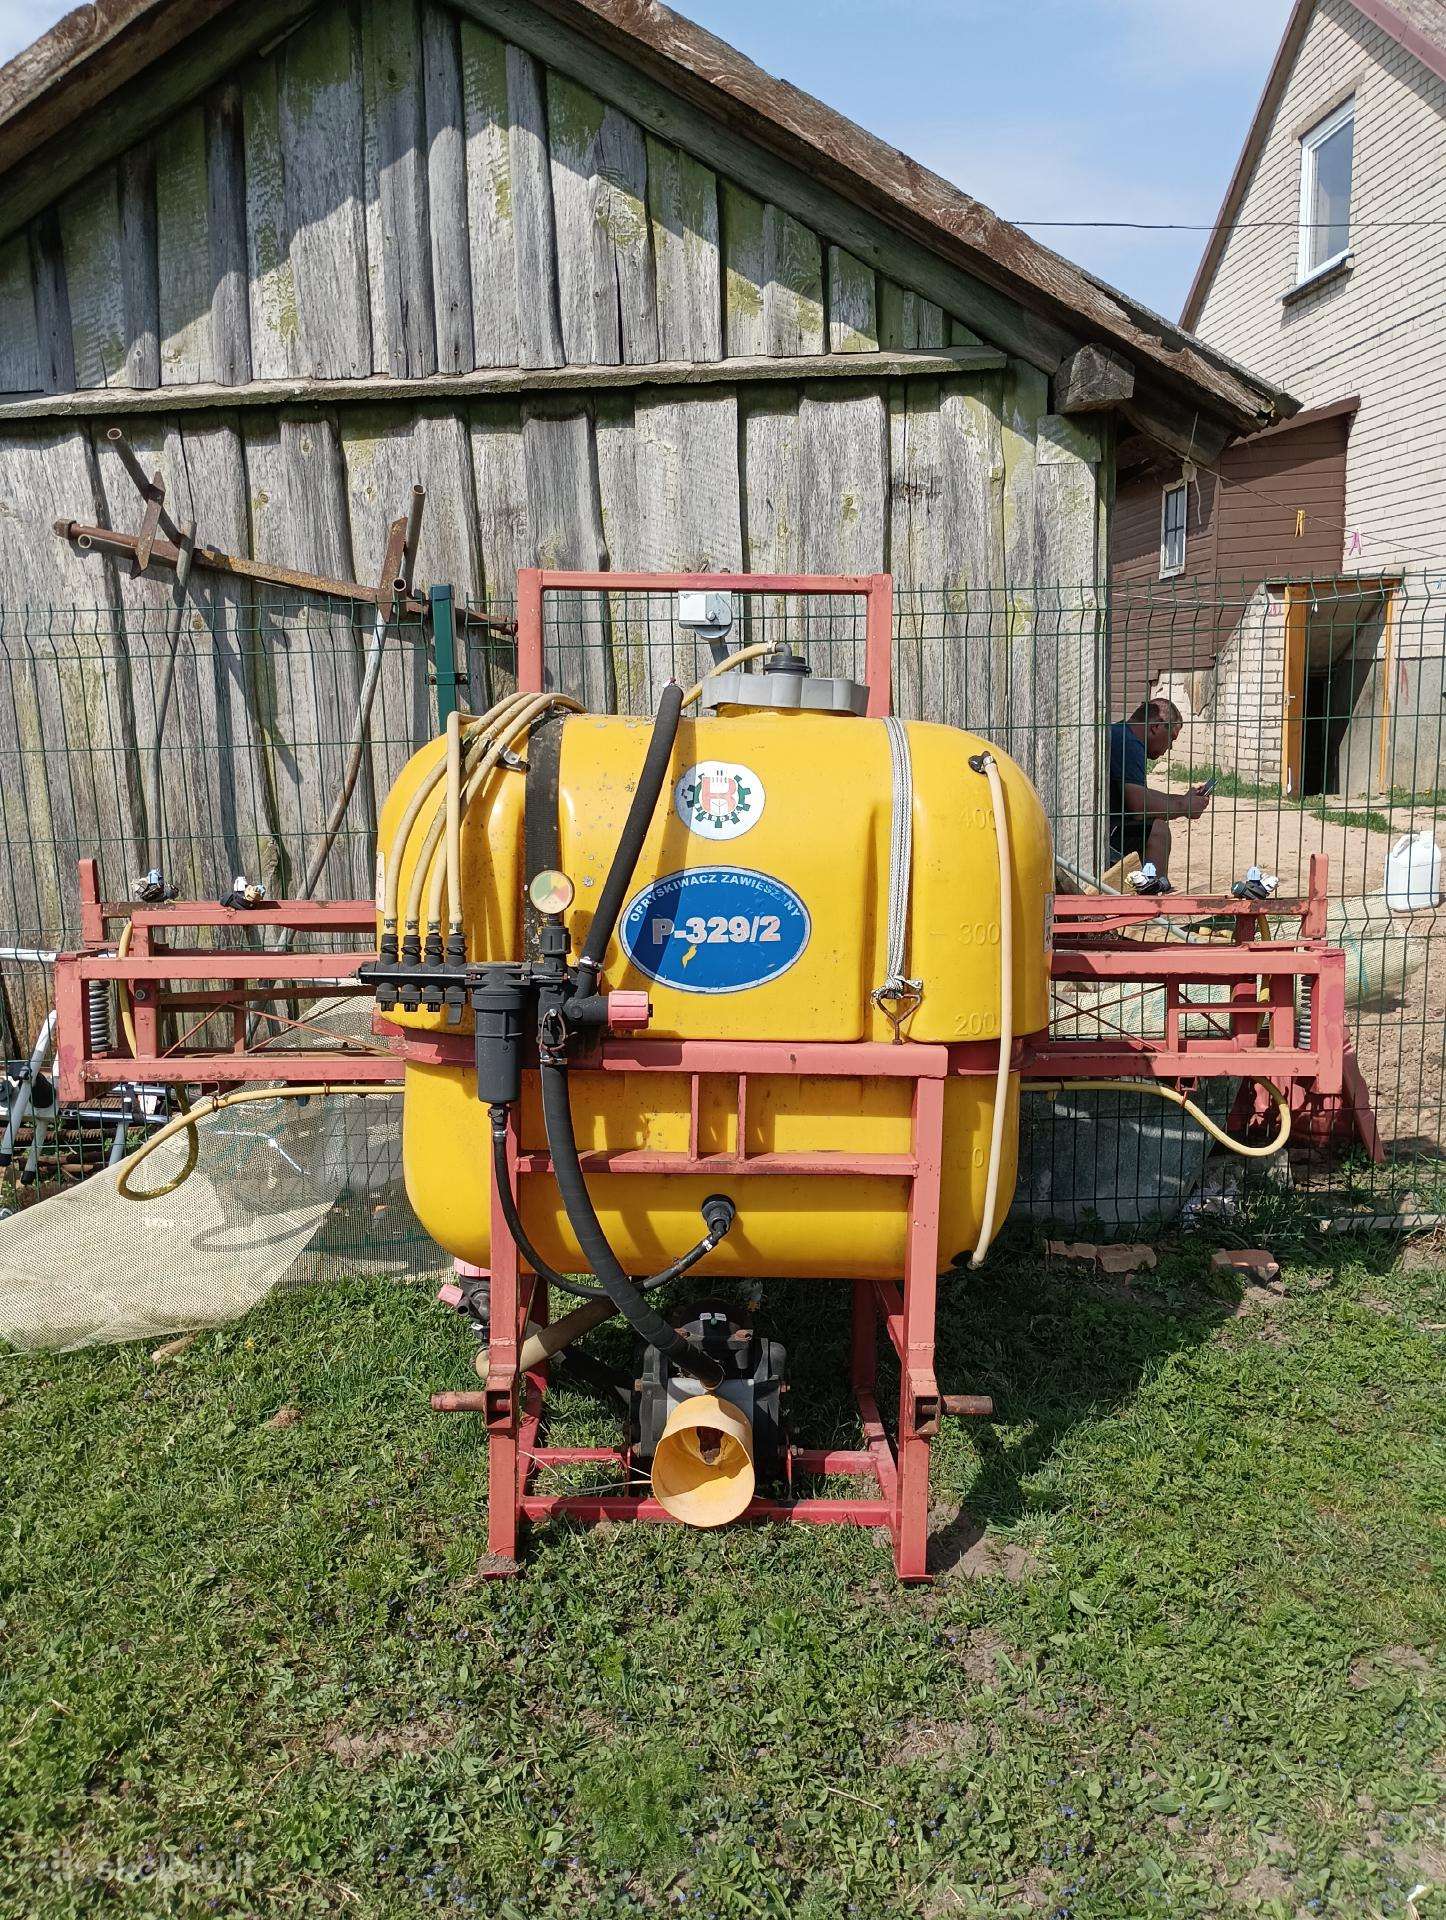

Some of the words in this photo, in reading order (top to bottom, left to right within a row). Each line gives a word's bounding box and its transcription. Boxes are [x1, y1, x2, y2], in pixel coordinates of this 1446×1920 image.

[630, 874, 718, 922] OPRYSKIWACZ
[652, 915, 782, 945] P-329/2
[959, 922, 1000, 945] 300
[953, 1012, 996, 1036] 200
